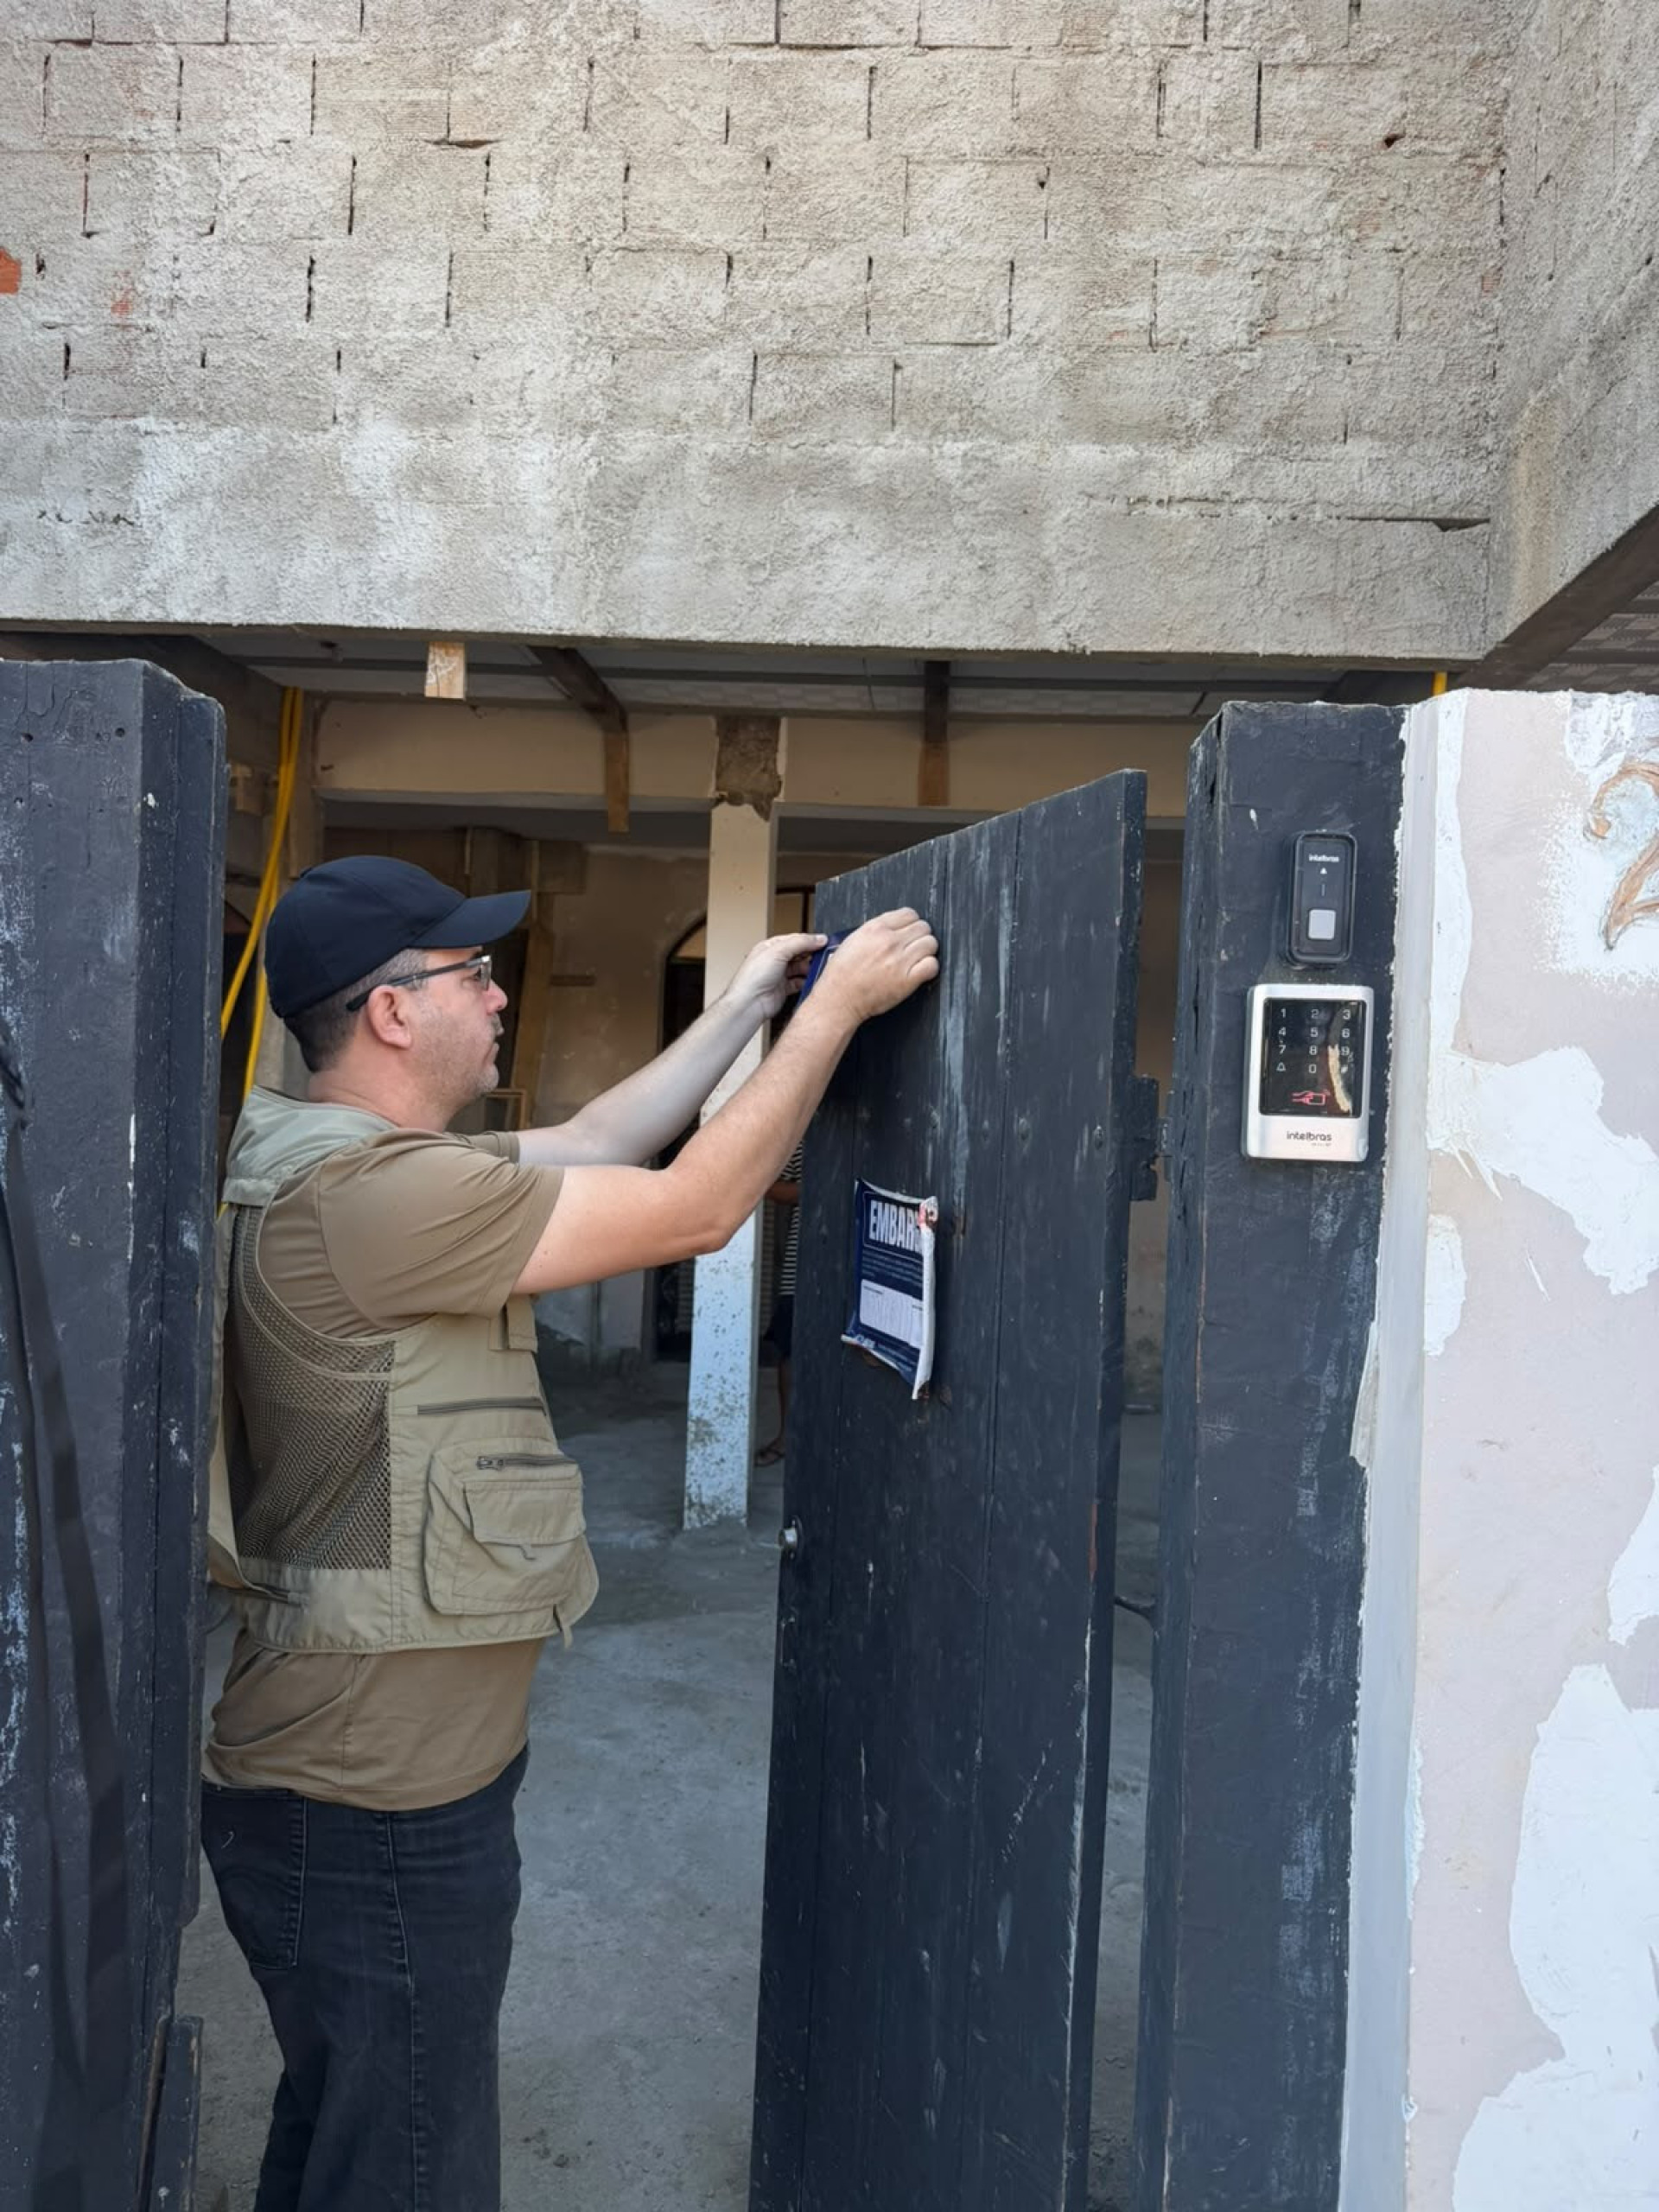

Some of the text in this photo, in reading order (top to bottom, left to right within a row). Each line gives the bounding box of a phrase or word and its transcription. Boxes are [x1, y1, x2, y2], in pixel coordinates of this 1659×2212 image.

[1281, 1008, 1351, 1020] 1 2 3
[1279, 1027, 1351, 1038] 4 5 6
[1279, 1045, 1350, 1056] 7 8 9
[1308, 1064, 1317, 1074] 0
[1287, 1131, 1332, 1141] intelbras
